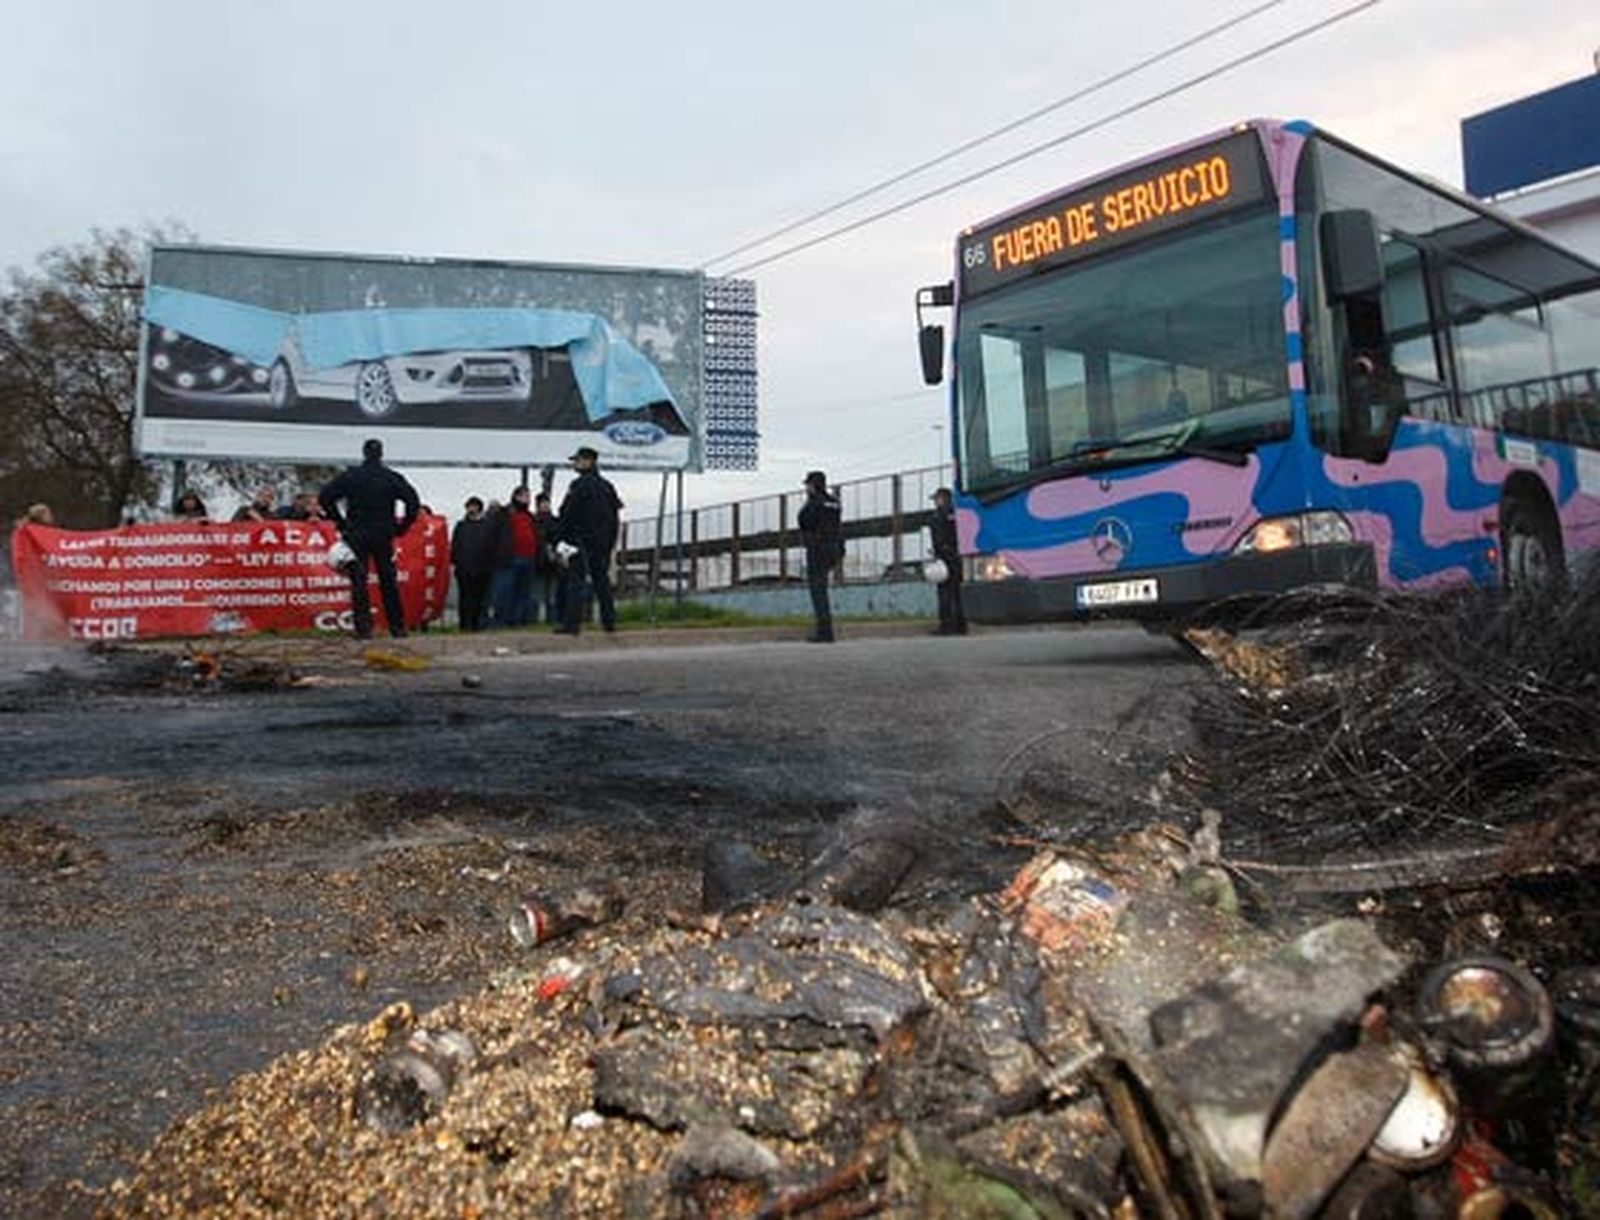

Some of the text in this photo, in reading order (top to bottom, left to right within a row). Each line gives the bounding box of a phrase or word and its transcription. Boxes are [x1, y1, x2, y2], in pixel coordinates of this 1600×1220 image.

[992, 156, 1229, 271] FUERA DE SERVICIO
[108, 556, 120, 569] A
